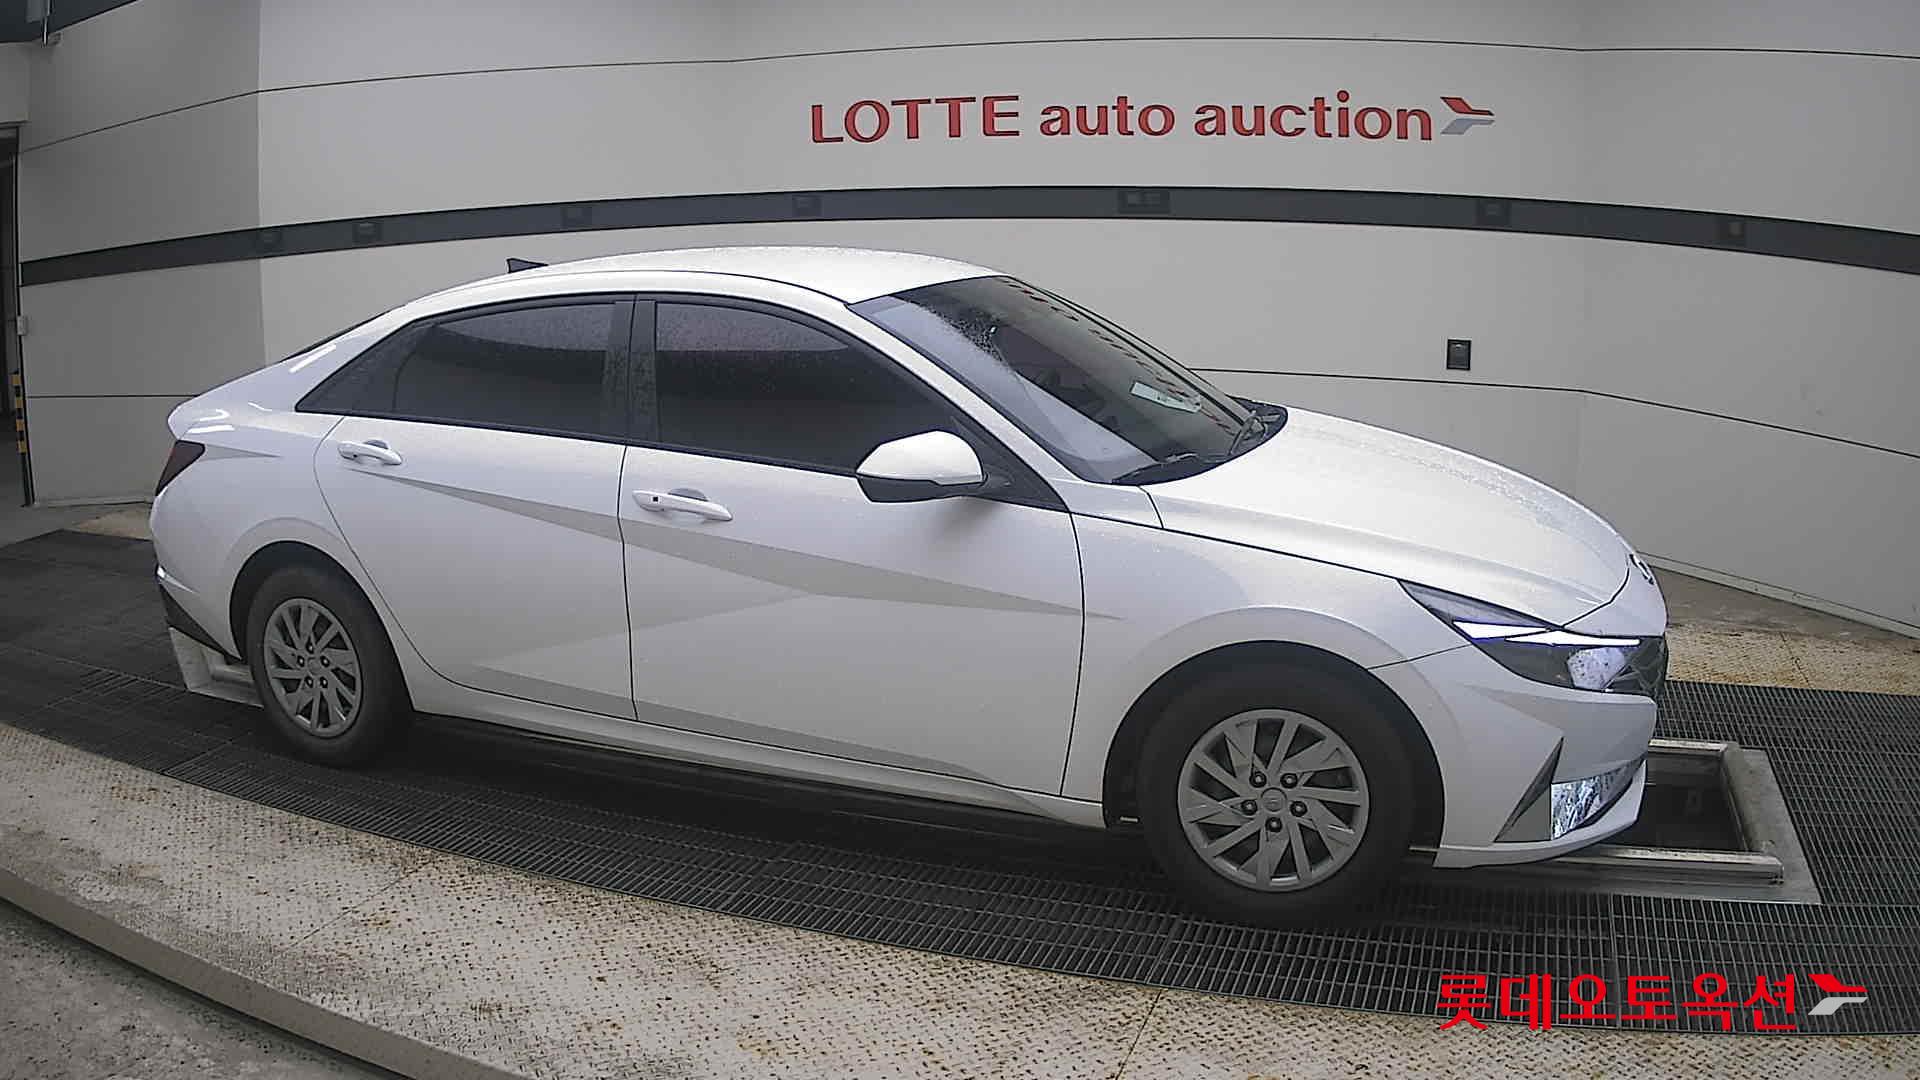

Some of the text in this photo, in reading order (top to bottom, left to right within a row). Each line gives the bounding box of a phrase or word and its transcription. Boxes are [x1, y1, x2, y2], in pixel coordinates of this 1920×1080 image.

[811, 90, 1433, 144] LOTTE auto auction
